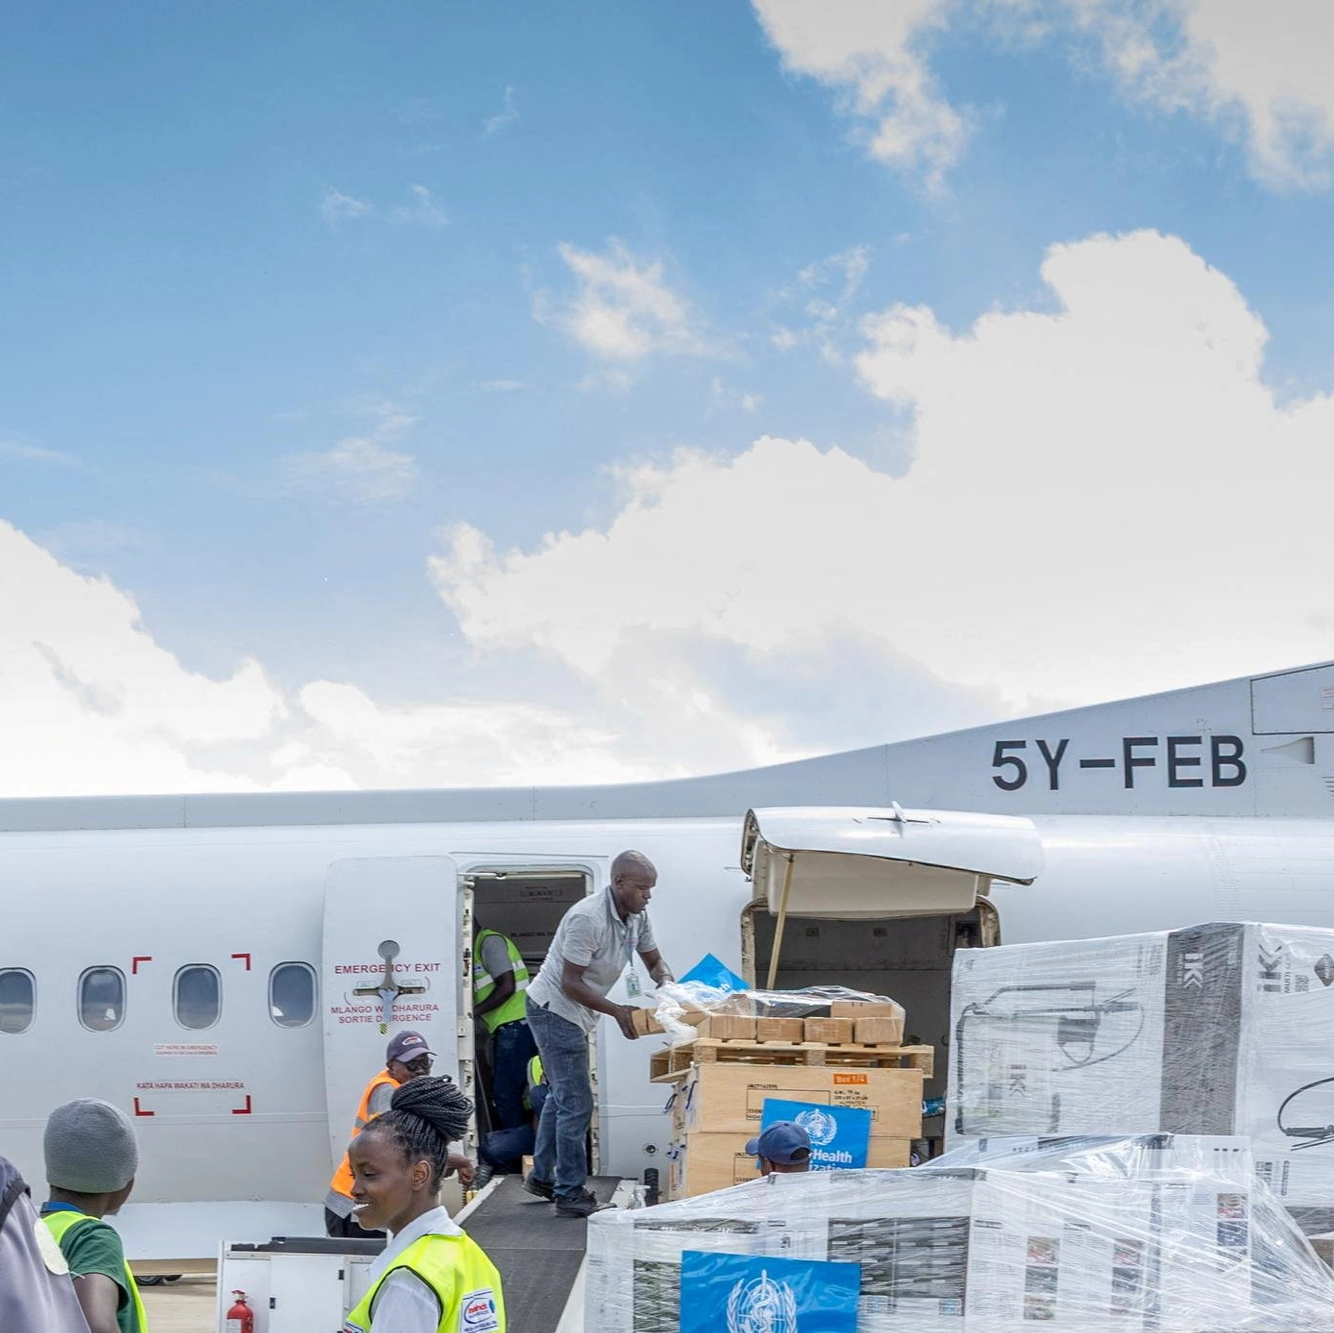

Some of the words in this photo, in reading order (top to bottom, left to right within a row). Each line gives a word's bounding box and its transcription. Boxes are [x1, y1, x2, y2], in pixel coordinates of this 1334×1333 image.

[991, 734, 1248, 791] 5Y-FEB
[334, 963, 412, 974] EMERGECY
[415, 963, 441, 972] EXIT
[331, 1006, 373, 1014] MLANGO
[392, 1004, 439, 1012] DHARURA
[339, 1015, 373, 1024] SORTIE
